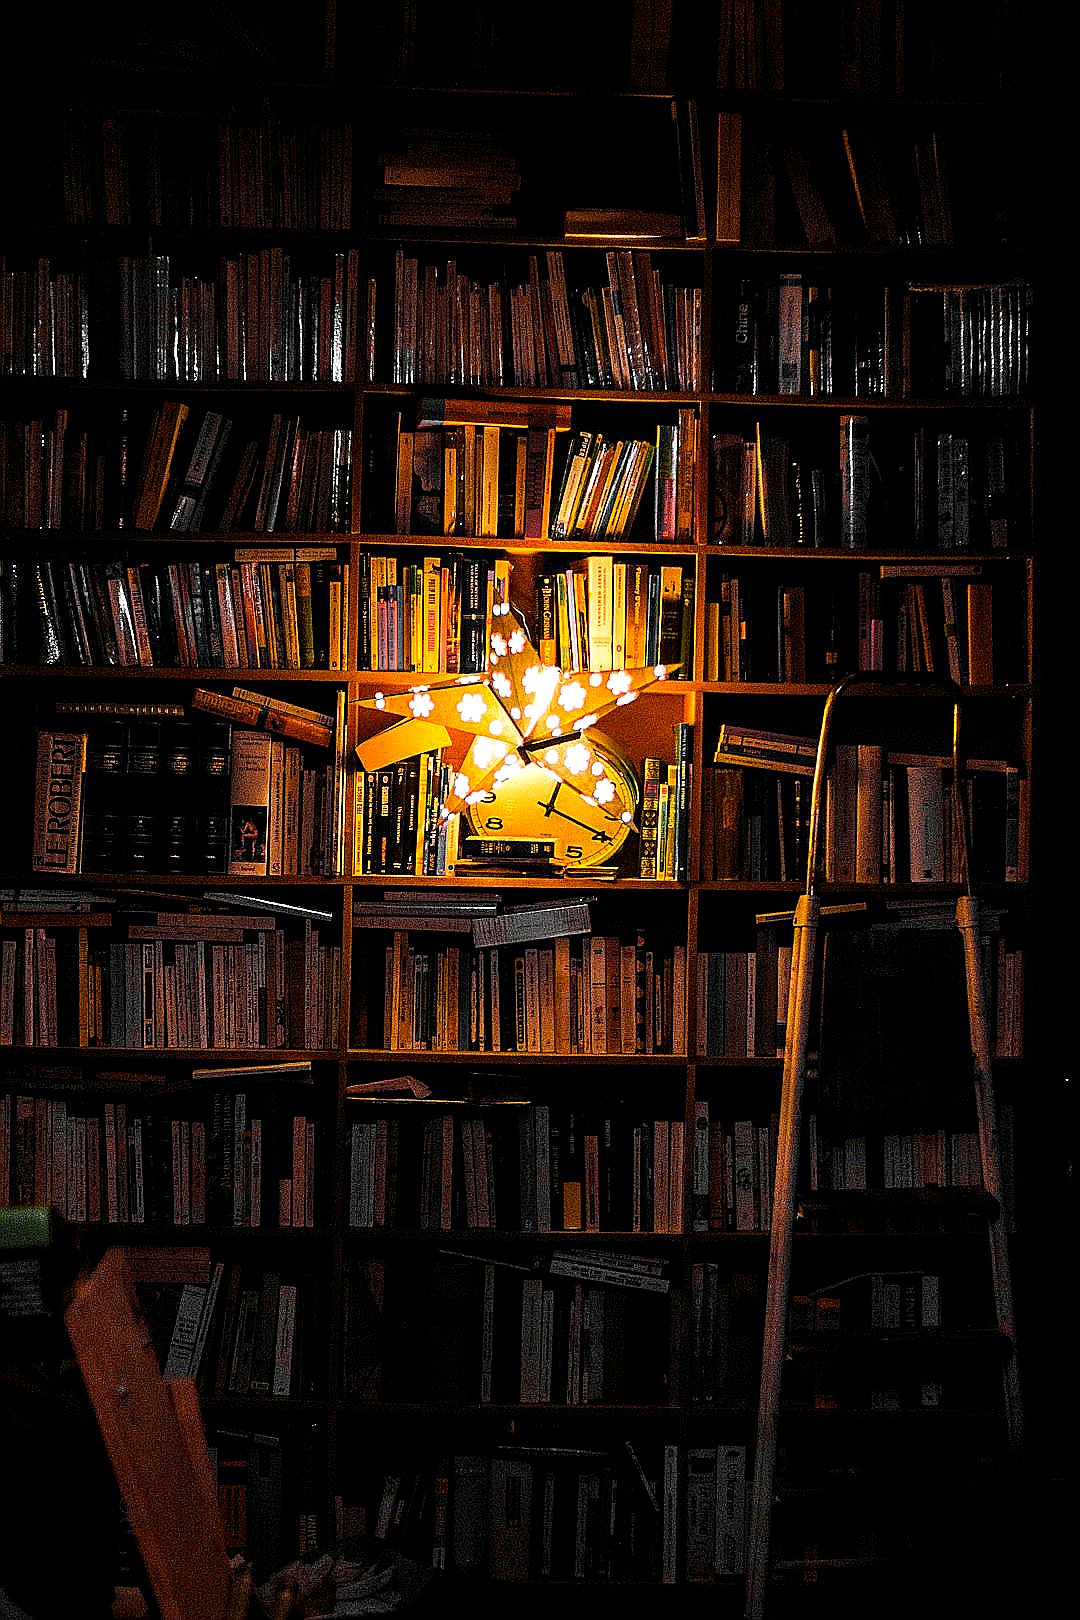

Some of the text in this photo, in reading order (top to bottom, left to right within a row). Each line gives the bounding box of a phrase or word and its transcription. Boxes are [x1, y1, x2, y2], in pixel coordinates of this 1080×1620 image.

[735, 303, 749, 344] Chine
[578, 437, 589, 456] PIPER
[428, 578, 436, 593] PHILIP
[634, 566, 642, 594] Flannery
[428, 594, 436, 605] ROTH
[543, 594, 551, 610] JOHN
[543, 610, 552, 639] GRISHAM
[45, 736, 75, 867] LE ROBERT
[485, 817, 504, 830] 8
[565, 845, 583, 858] 5
